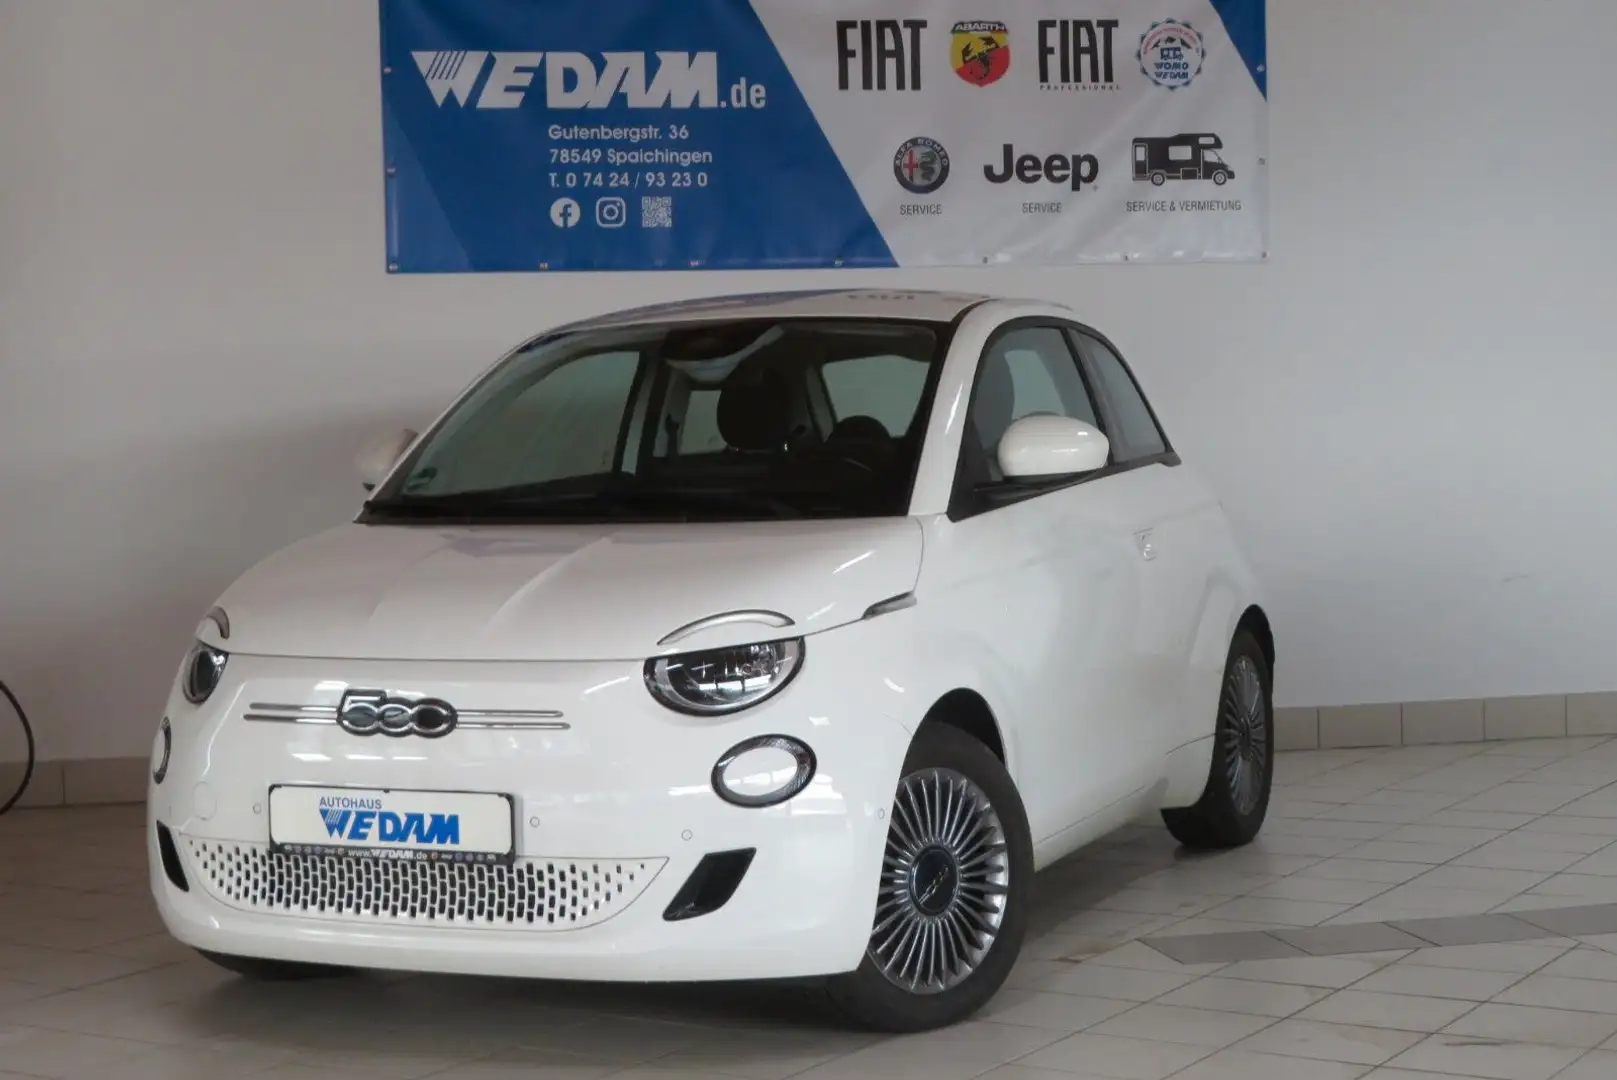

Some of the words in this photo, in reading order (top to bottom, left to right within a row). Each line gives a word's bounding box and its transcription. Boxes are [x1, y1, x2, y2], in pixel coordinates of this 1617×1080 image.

[954, 22, 1006, 31] ABARTH
[836, 19, 927, 91] FIAT
[1038, 19, 1119, 83] FIAT
[548, 124, 662, 142] Gutenbergstr.
[668, 124, 689, 140] 36
[549, 149, 602, 164] 78549
[607, 148, 713, 167] Spaichingen
[983, 143, 1099, 192] Jeep
[549, 173, 560, 188] T.
[565, 173, 576, 188] 0
[583, 173, 604, 188] 74
[609, 173, 630, 188] 24
[645, 173, 666, 188] 93
[671, 173, 692, 187] 23
[697, 173, 708, 187] 0
[900, 204, 942, 215] SERVICE
[1022, 202, 1062, 213] SERVICE
[1126, 201, 1167, 212] SERVICE
[1169, 201, 1176, 212] &
[1179, 200, 1242, 211] VERMIETUNG
[338, 690, 456, 737] 500
[319, 796, 382, 810] AUTOHAUS
[319, 809, 460, 845] WEDAM
